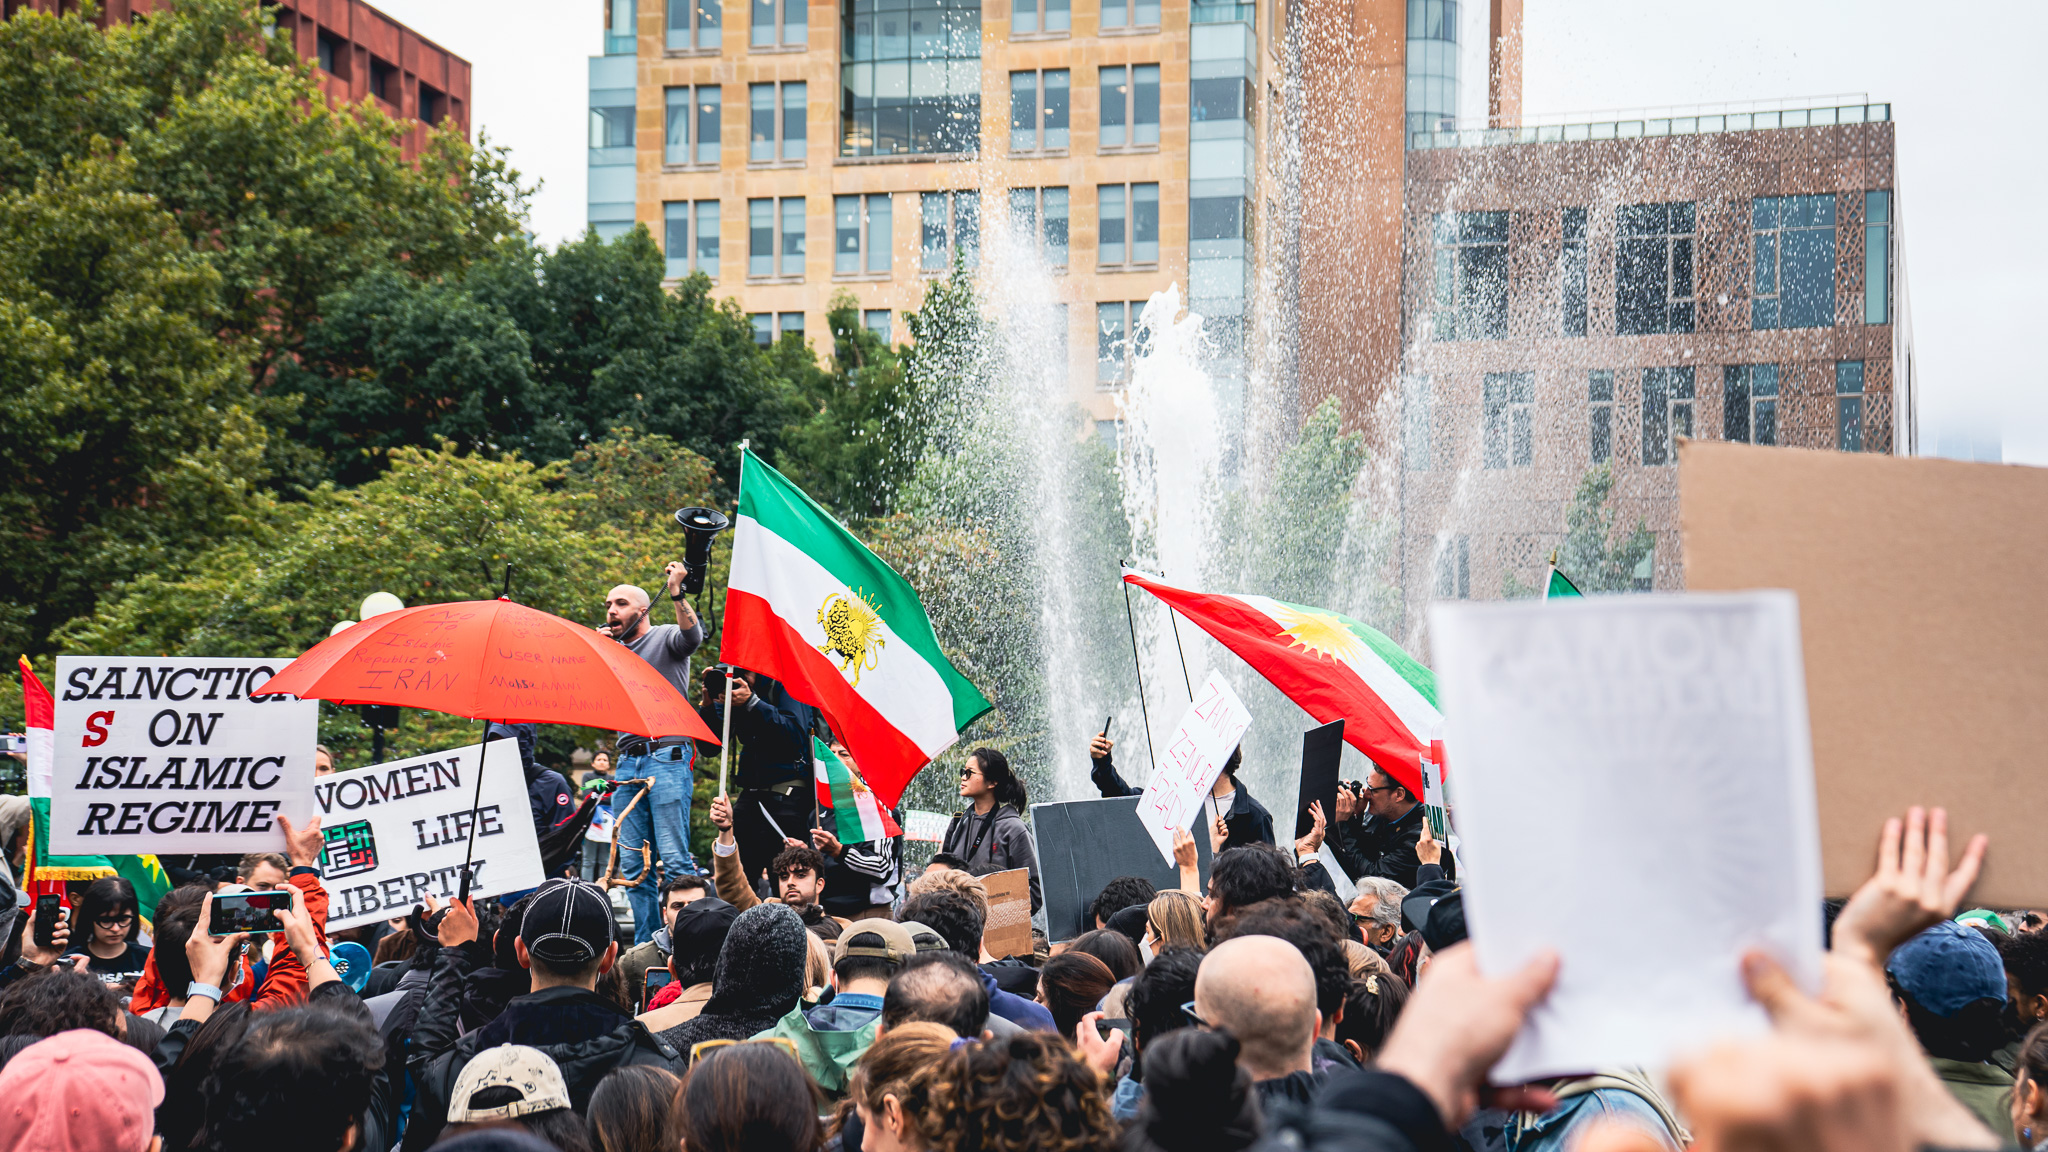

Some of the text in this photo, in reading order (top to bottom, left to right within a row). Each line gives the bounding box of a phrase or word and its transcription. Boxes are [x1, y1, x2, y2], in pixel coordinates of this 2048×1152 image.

[352, 648, 454, 668] Republic of
[358, 669, 460, 692] IRAN
[82, 708, 224, 747] S ON
[1194, 682, 1234, 738] ZAN
[75, 756, 286, 790] ISLAMIC
[315, 756, 461, 814] WOMEN
[77, 800, 281, 836] REGIME
[412, 804, 505, 851] LIFE
[327, 859, 487, 922] LIBERTY
